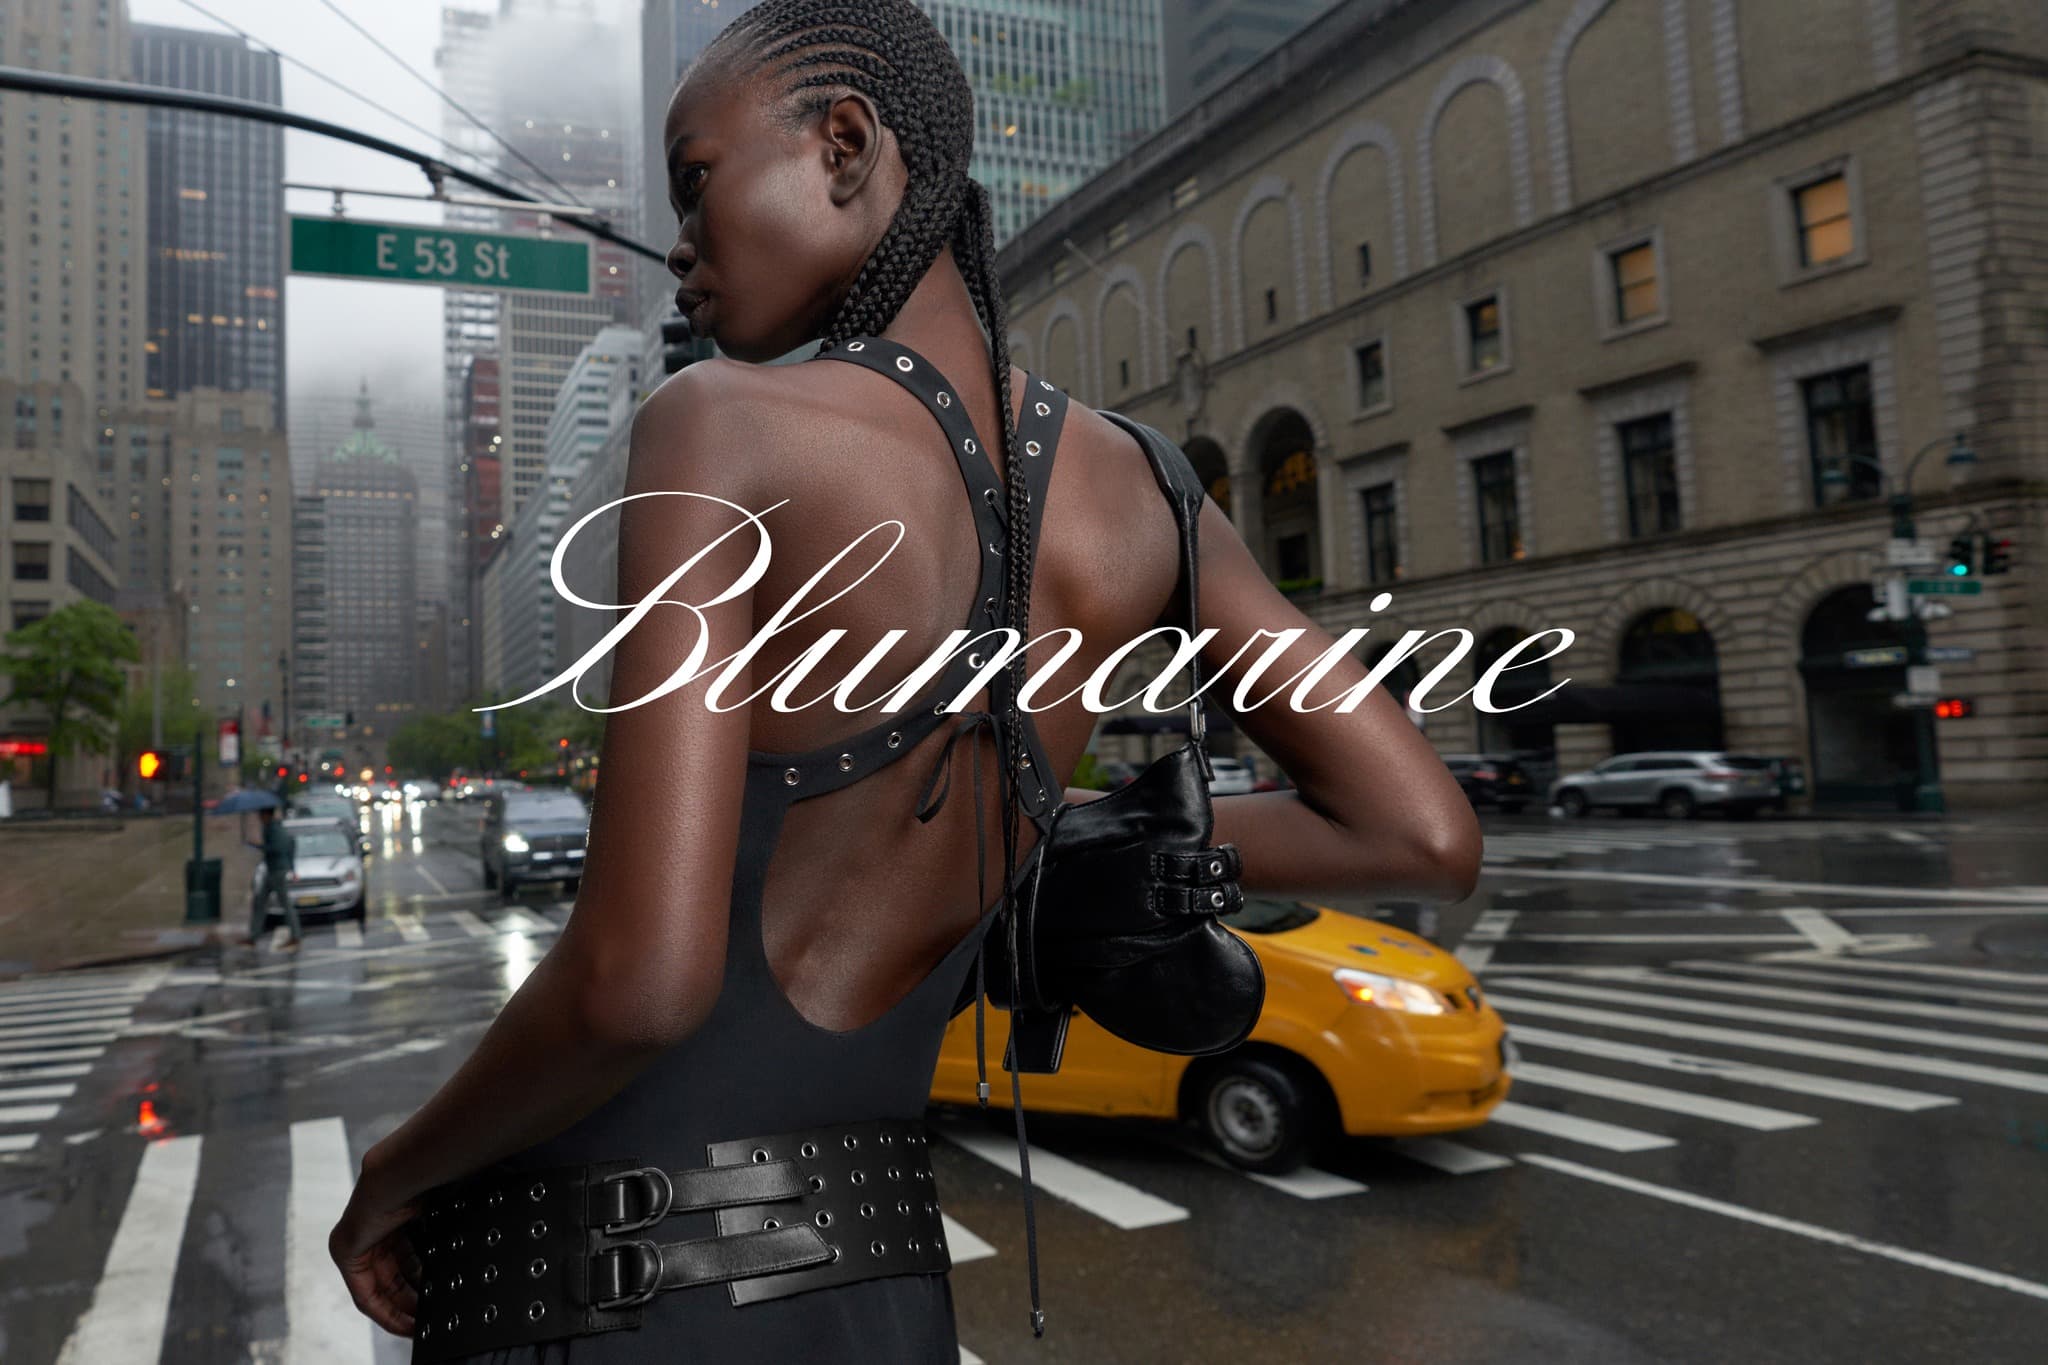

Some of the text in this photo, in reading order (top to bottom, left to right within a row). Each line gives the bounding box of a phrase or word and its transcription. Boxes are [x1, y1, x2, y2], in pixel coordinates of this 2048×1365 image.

[376, 233, 511, 278] E 53 St
